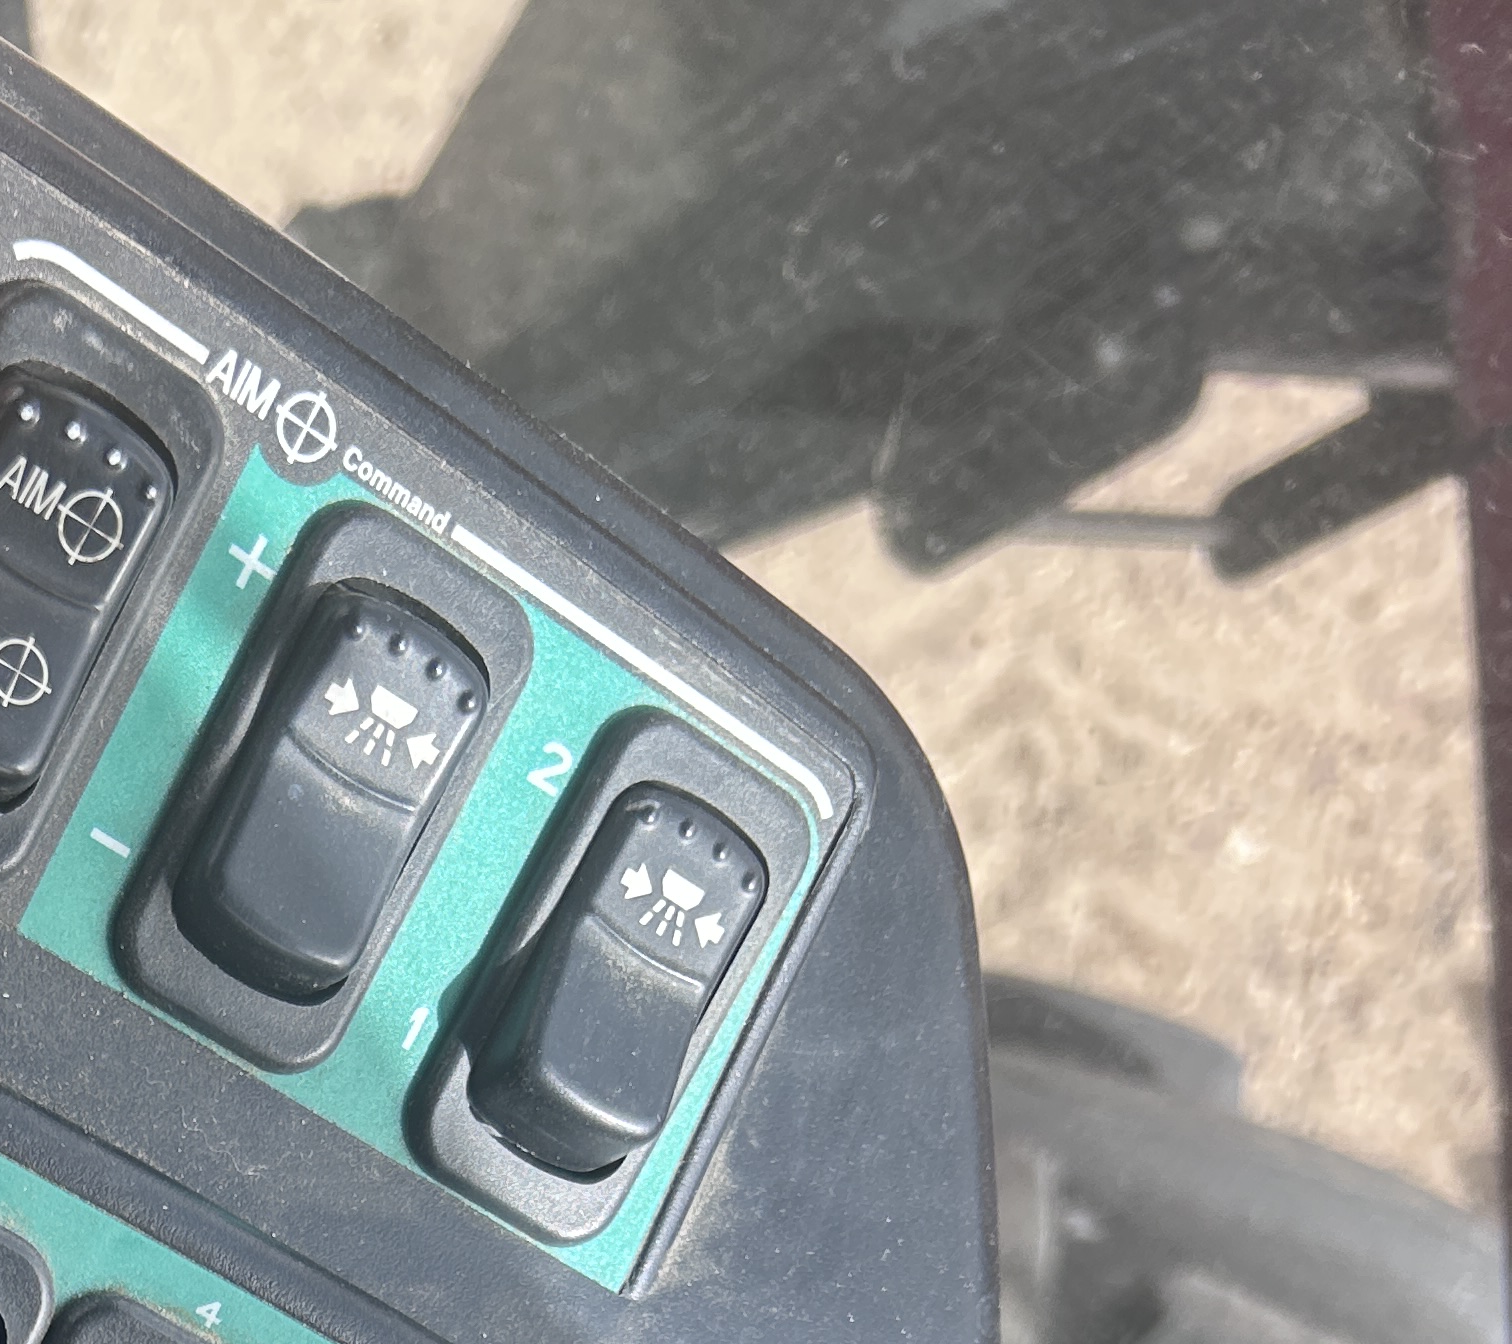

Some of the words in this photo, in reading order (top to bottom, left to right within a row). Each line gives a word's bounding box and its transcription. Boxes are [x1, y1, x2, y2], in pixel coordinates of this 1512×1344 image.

[205, 349, 281, 421] AIM
[341, 446, 453, 535] Command
[527, 741, 573, 797] 2
[402, 1005, 429, 1050] 1
[195, 1301, 221, 1329] 4
